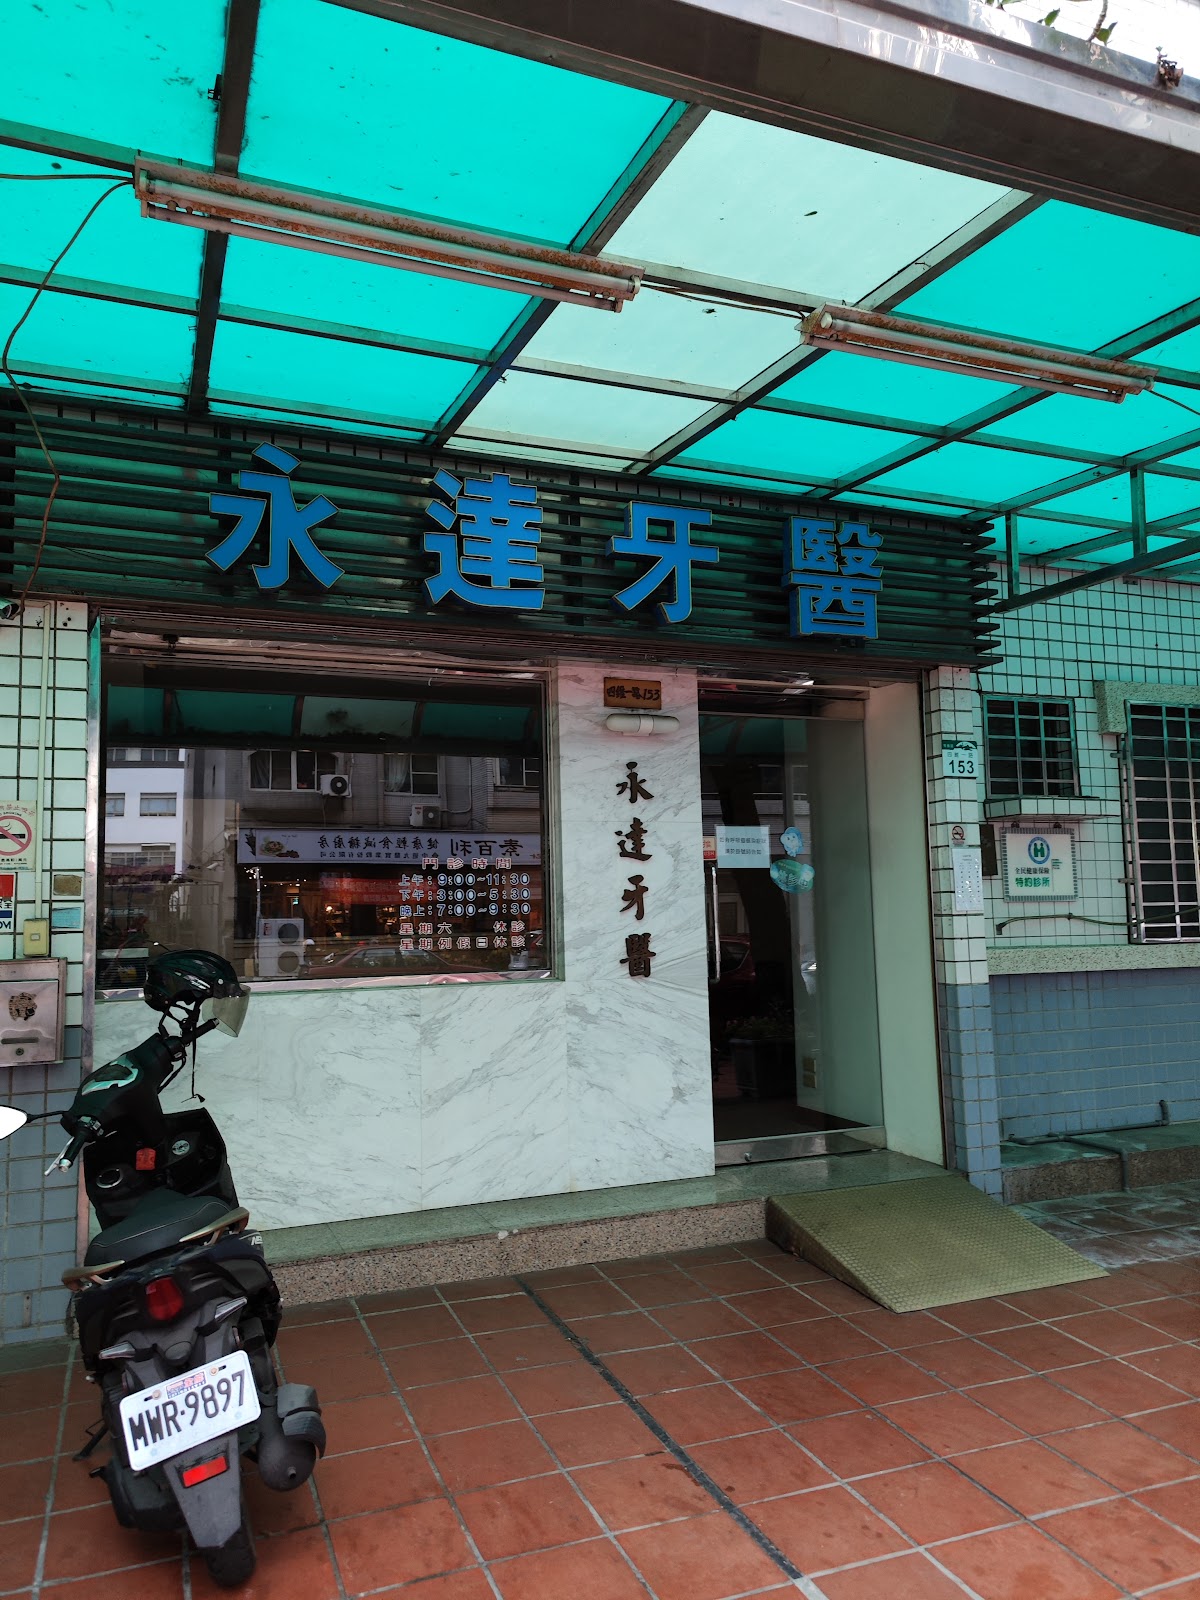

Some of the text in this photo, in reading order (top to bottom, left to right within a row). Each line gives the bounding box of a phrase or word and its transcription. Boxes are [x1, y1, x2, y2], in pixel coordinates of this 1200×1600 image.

[205, 442, 884, 640] 永達牙醫
[949, 760, 975, 774] 153
[421, 857, 513, 870] 門診時間
[615, 761, 657, 978] 永達牙醫
[1015, 866, 1050, 875] 全民健康保險
[1014, 876, 1050, 888] 特約診所
[399, 920, 527, 936] 星期六 休診
[399, 936, 527, 951] 星期例假日休診
[128, 1368, 246, 1451] MWR-9897
